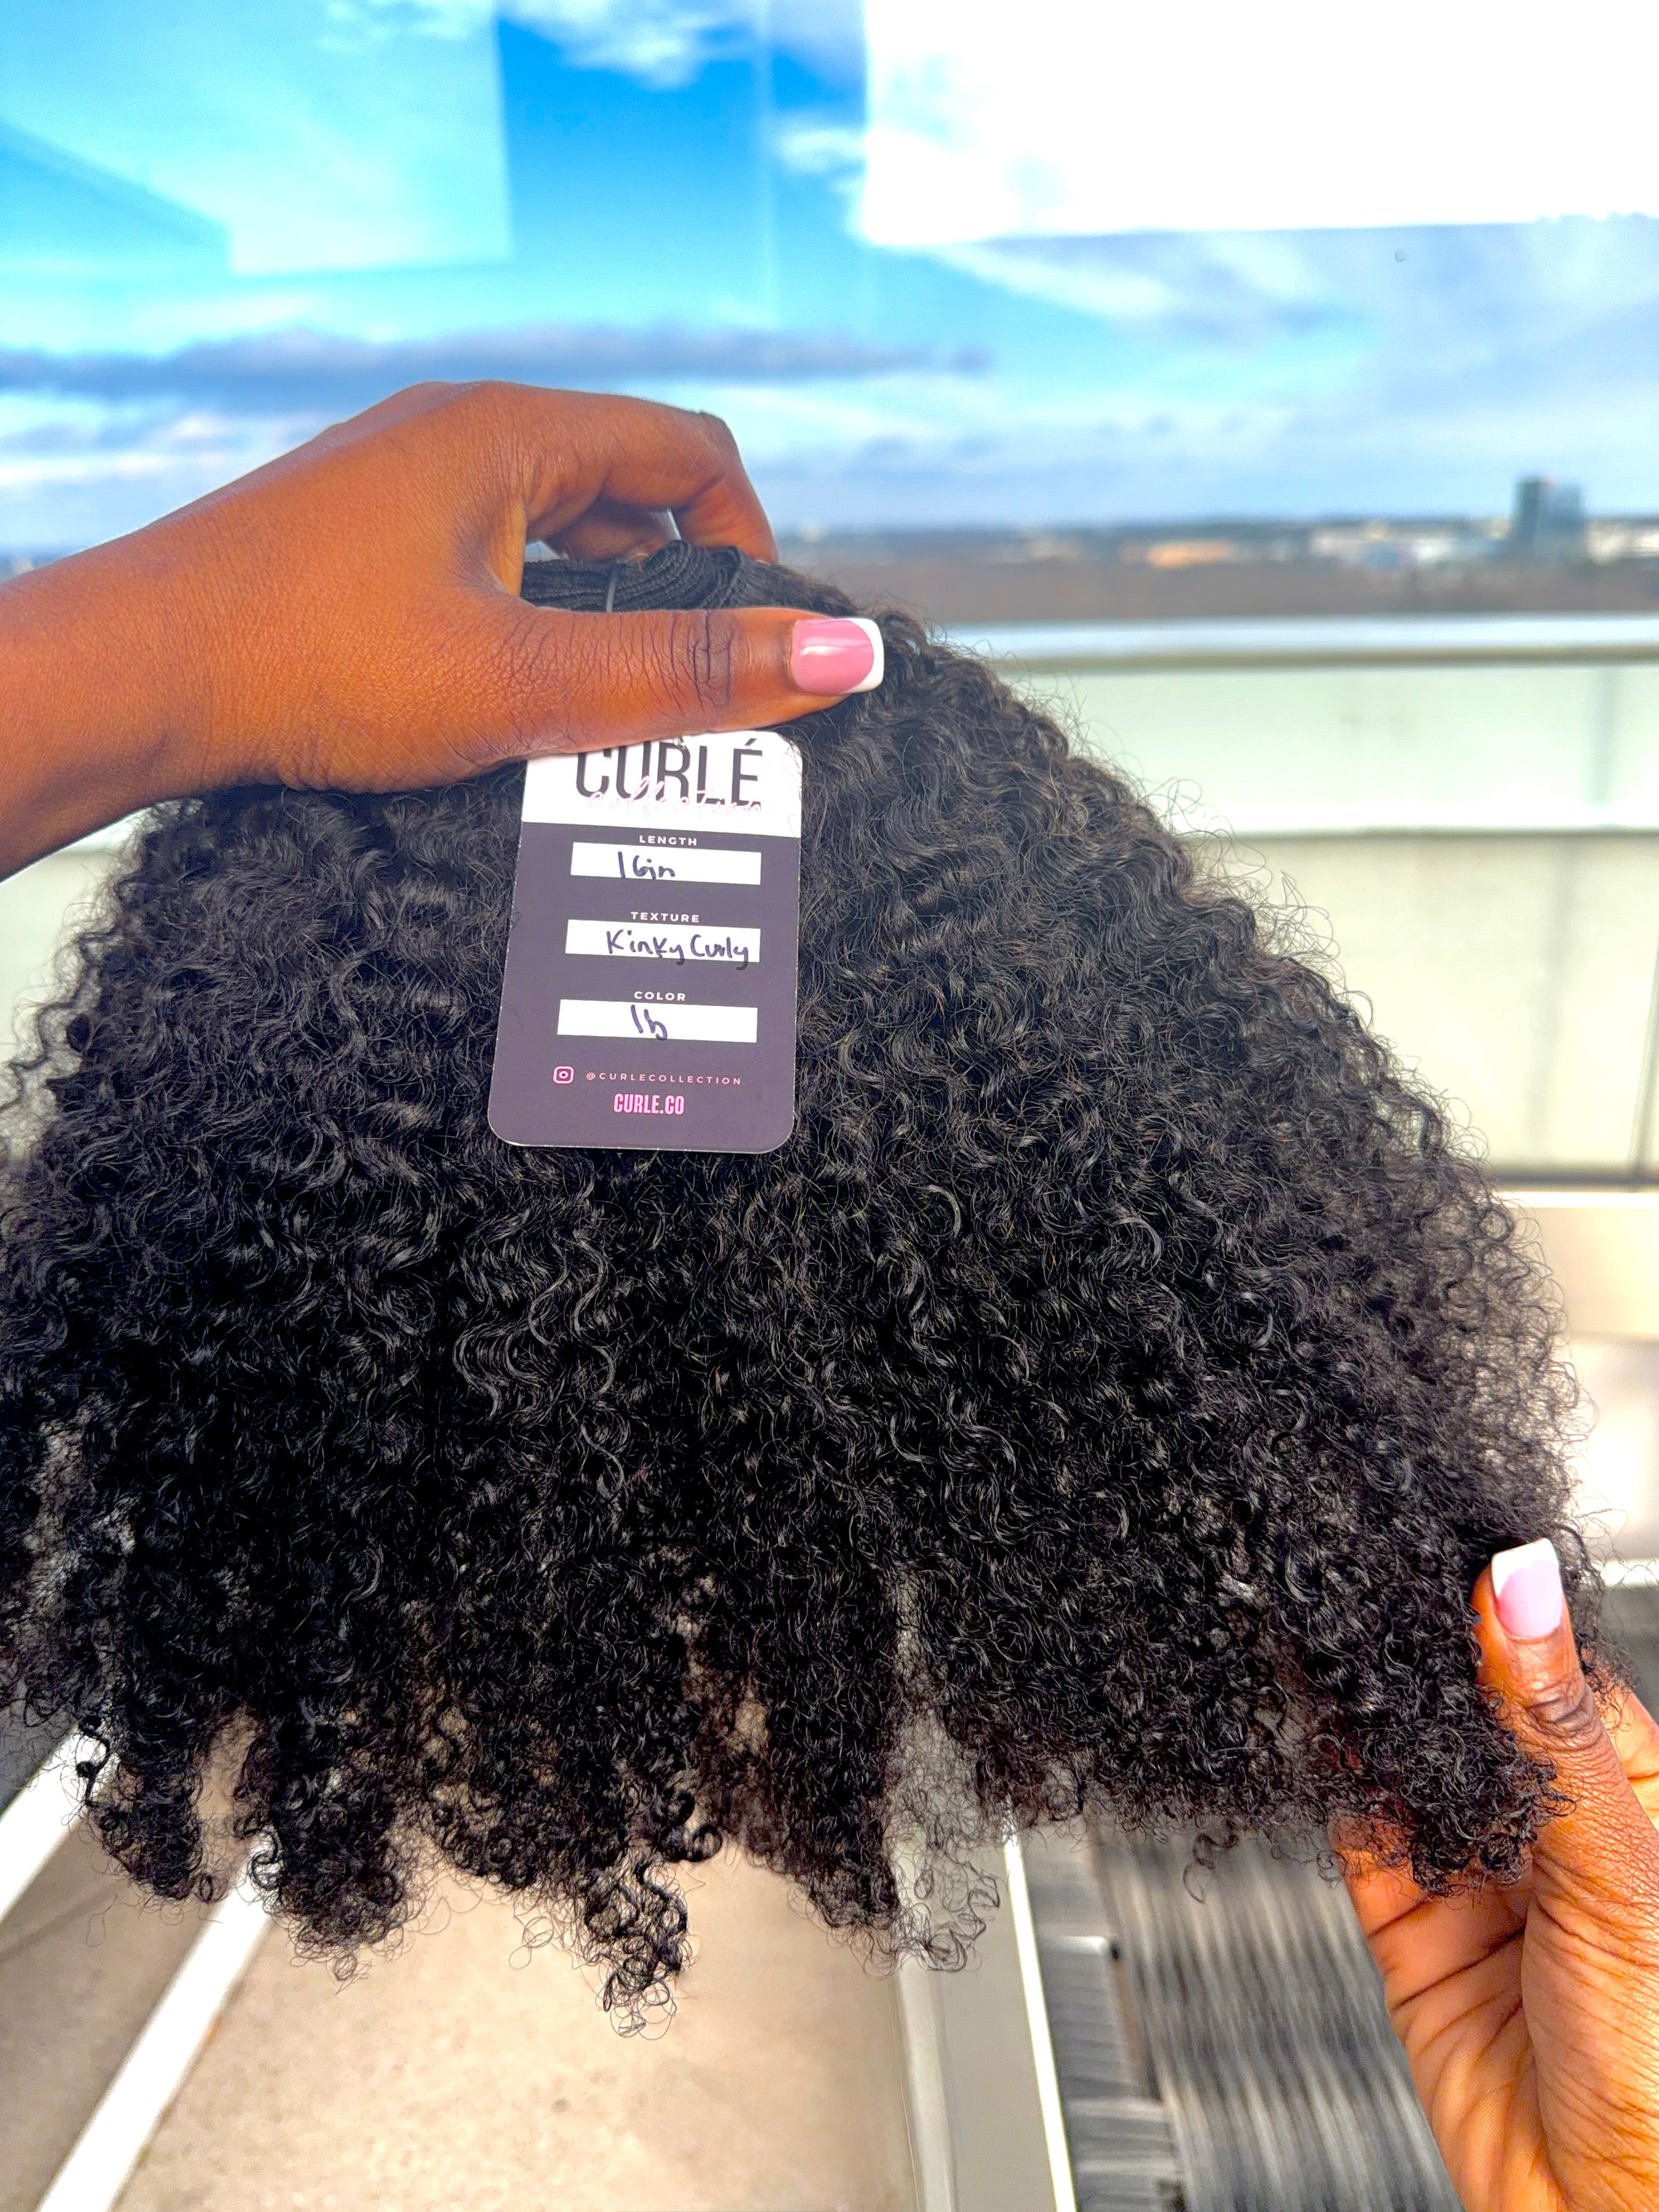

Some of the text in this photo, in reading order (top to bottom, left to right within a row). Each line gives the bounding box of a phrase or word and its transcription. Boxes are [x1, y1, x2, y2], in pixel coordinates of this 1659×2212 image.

[576, 737, 762, 807] CURLÉ
[639, 834, 698, 846] LENGTH
[617, 851, 676, 879] 16in
[630, 912, 700, 923] TEXTURE
[606, 929, 749, 970] Kinky Curly
[634, 990, 687, 1001] COLOR
[586, 1072, 742, 1086] @CURLECOLLECTION
[613, 1093, 685, 1116] CURLE.CO
